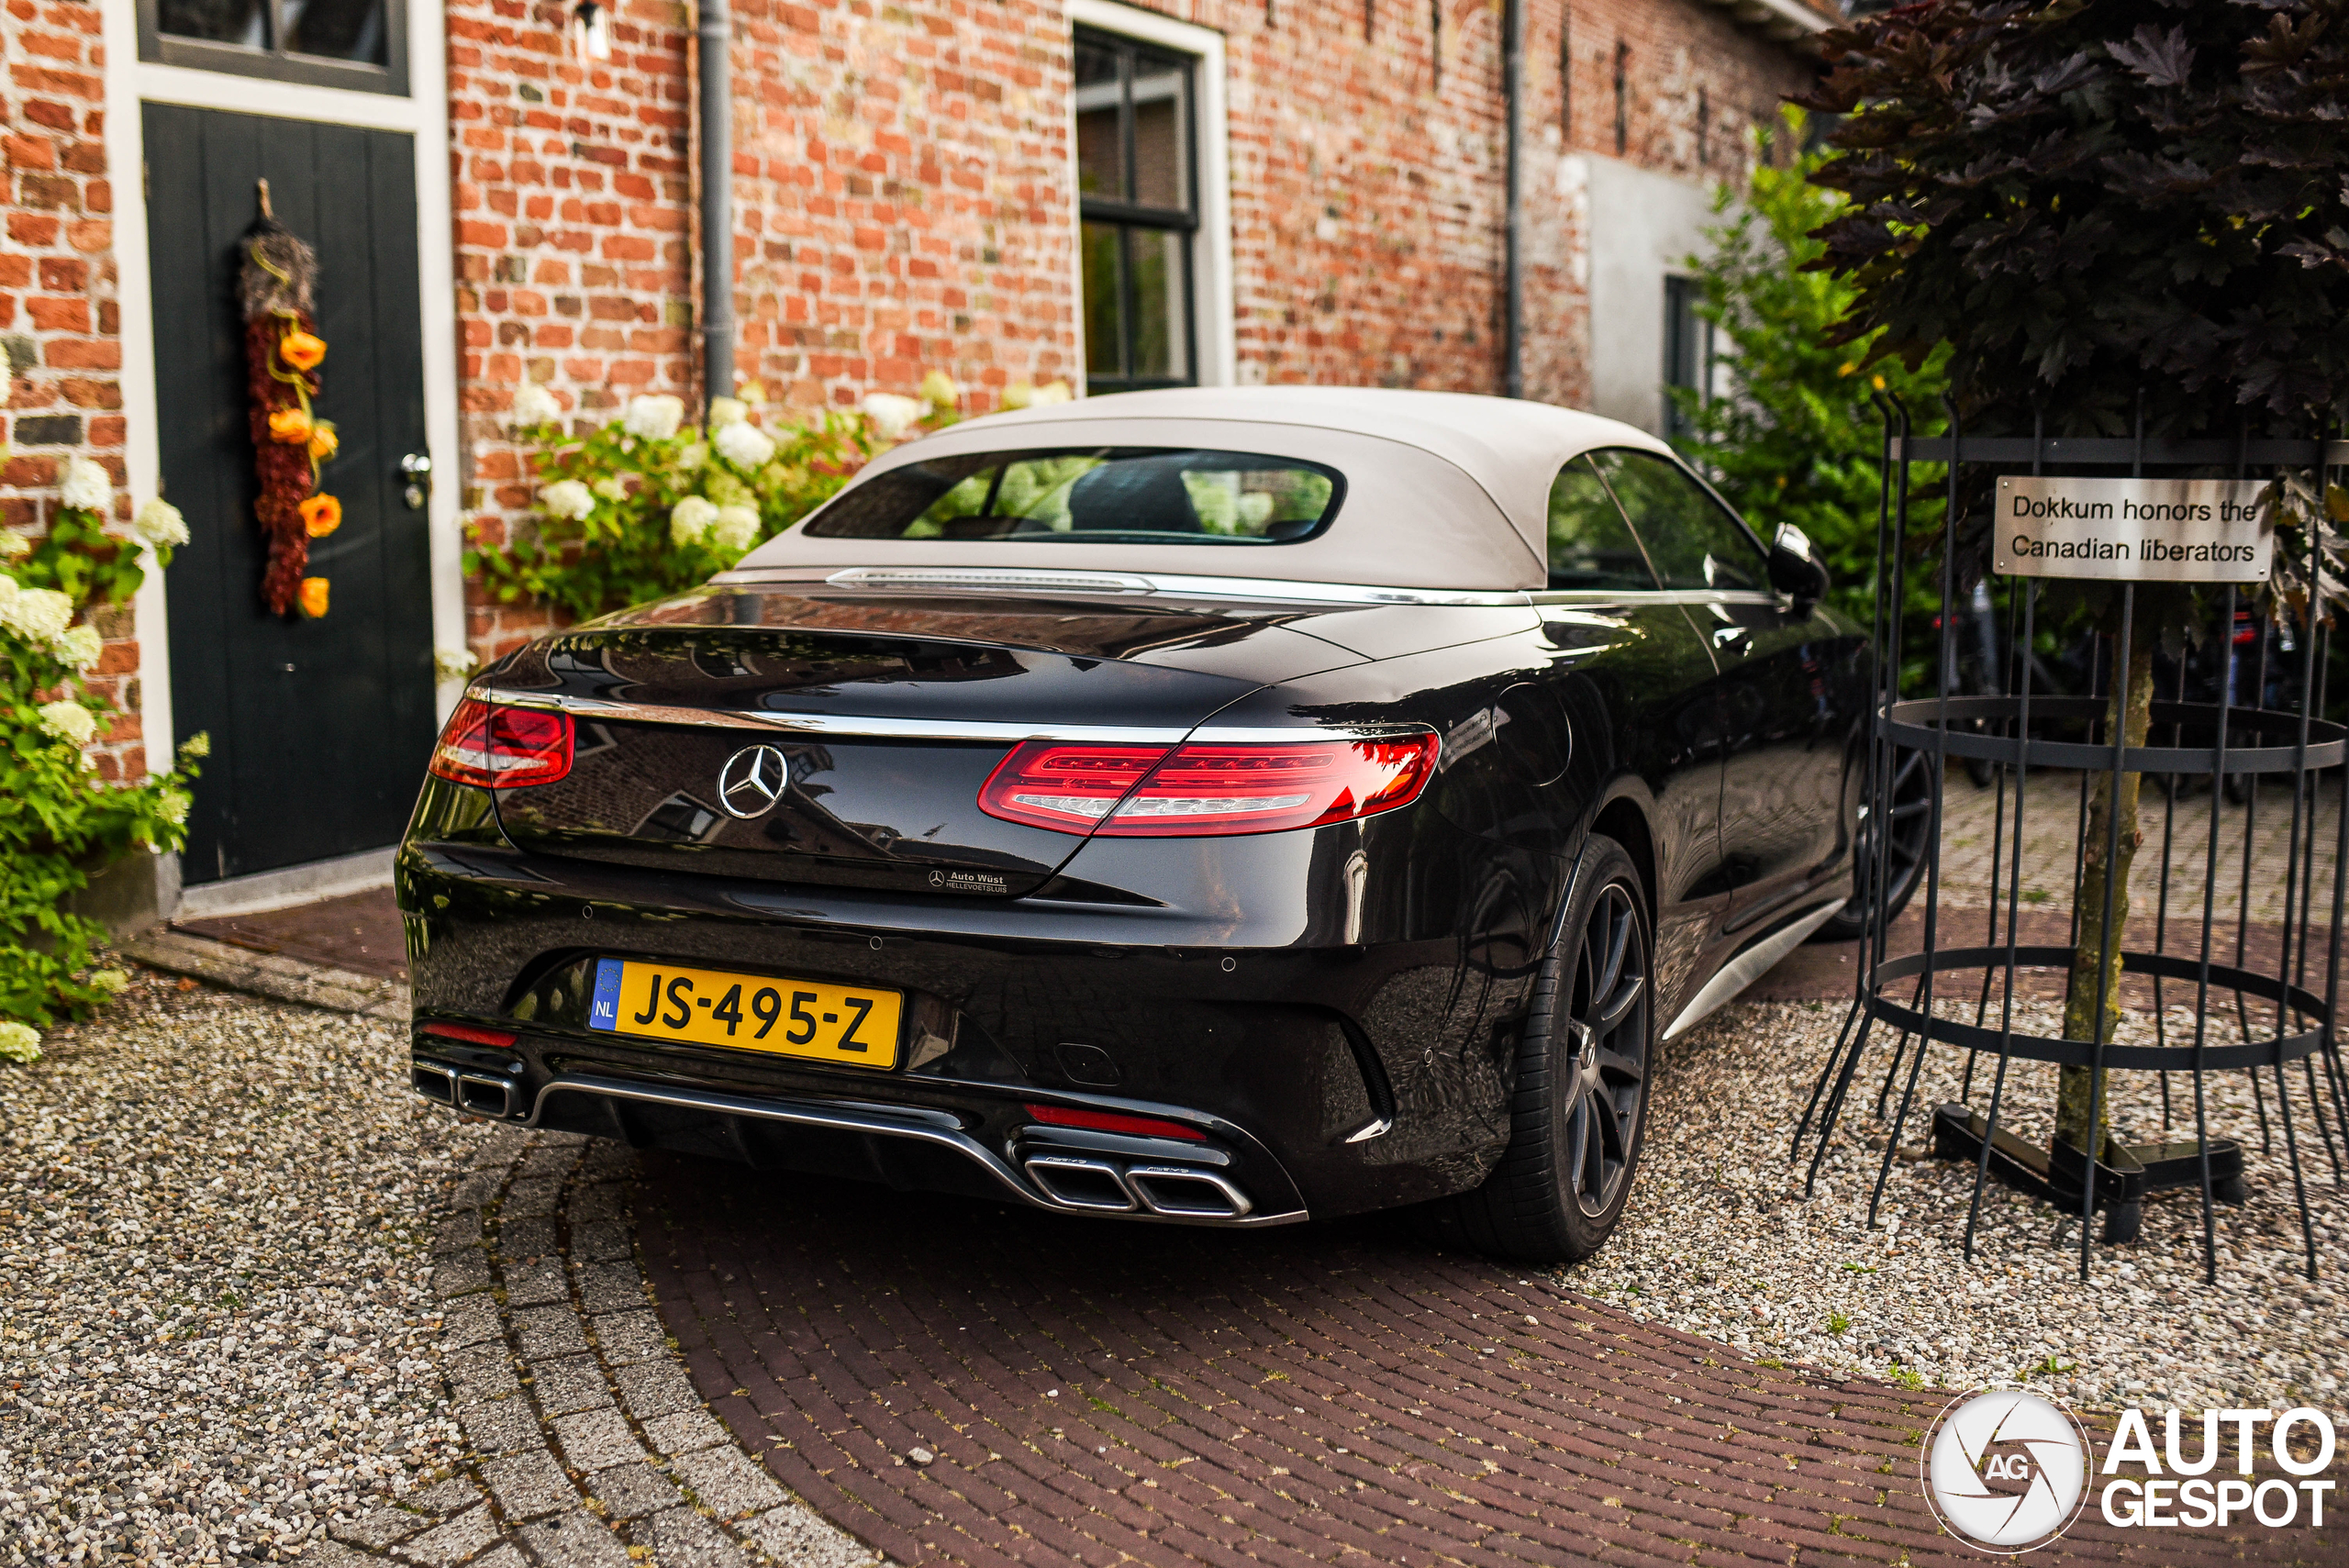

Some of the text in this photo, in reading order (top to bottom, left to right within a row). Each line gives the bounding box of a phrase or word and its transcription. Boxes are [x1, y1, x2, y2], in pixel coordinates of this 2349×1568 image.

[2013, 495, 2256, 522] Dokkum honors the
[2011, 535, 2254, 562] Canadian liberators
[946, 882, 1008, 894] HELLEVOETSLUIS
[951, 872, 1004, 884] Auto Wüst
[595, 1000, 614, 1018] NL
[634, 973, 874, 1052] JS-495-Z
